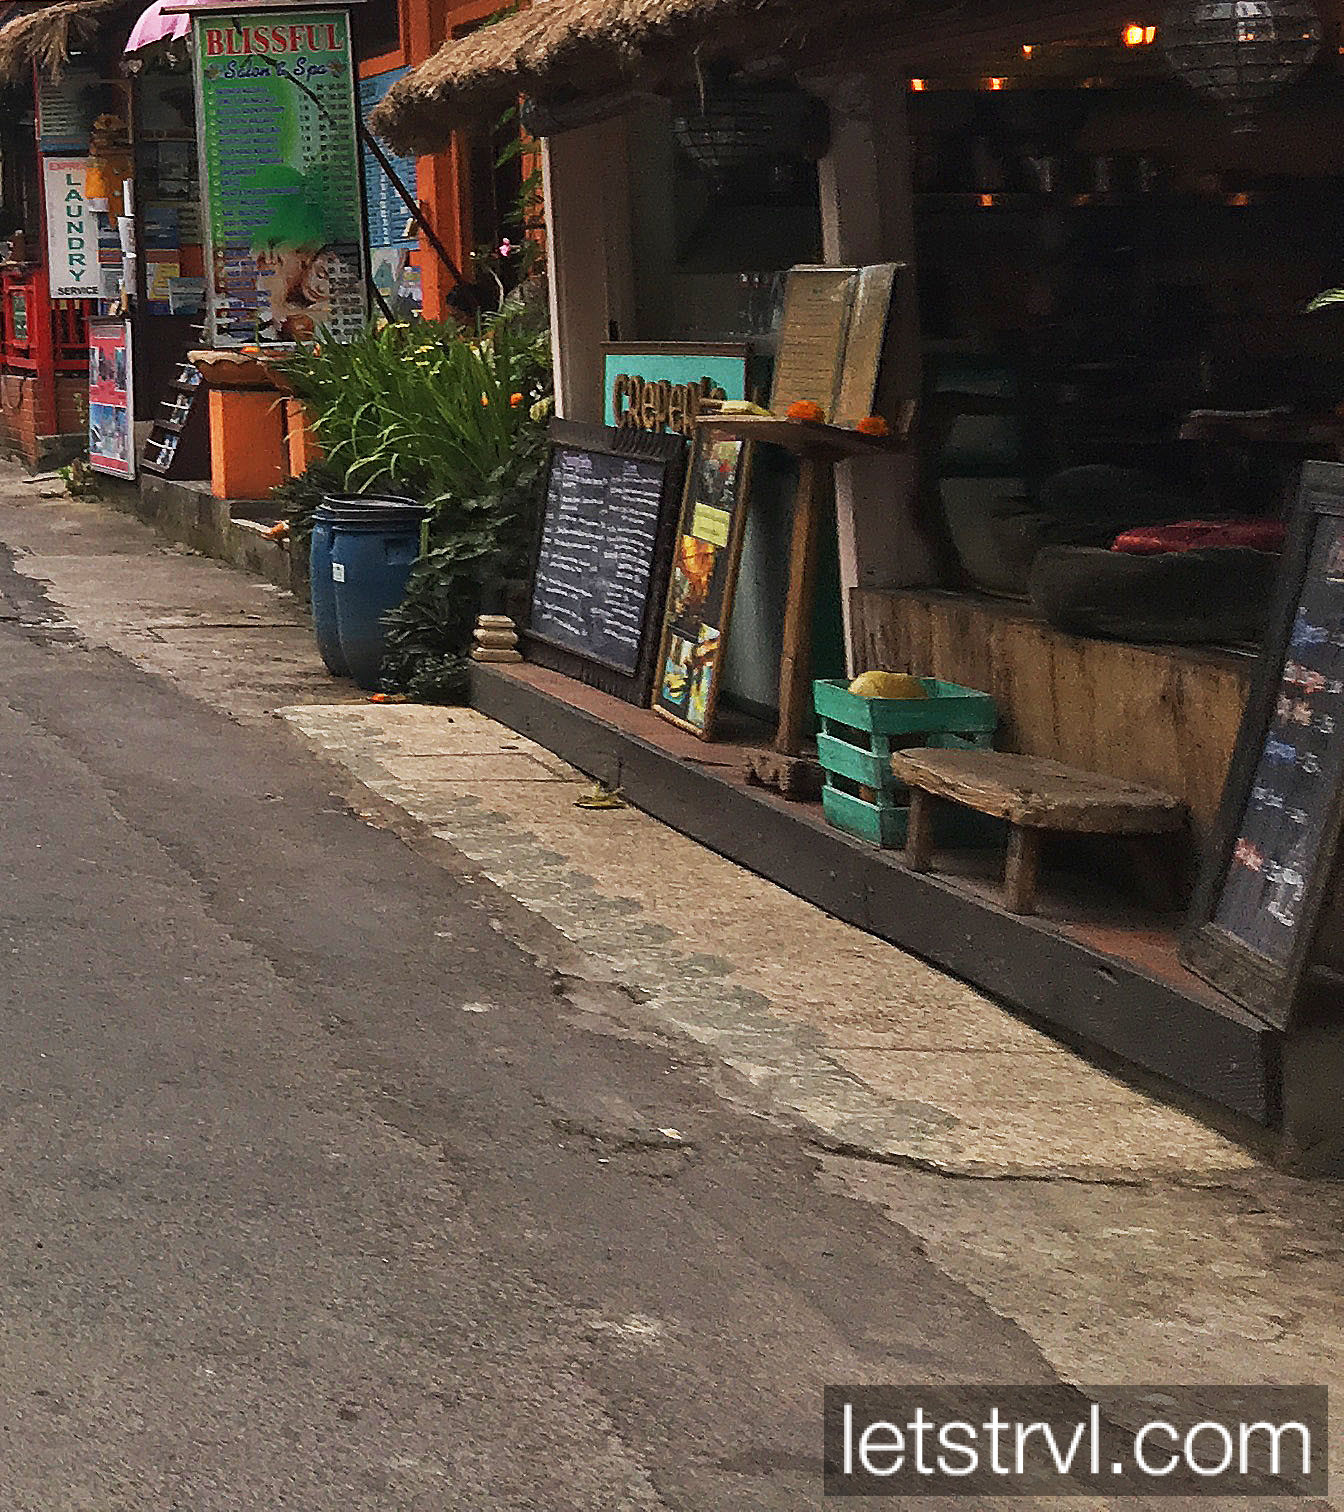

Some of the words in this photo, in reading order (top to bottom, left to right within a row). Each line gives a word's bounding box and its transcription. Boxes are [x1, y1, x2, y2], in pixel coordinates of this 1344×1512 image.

[206, 24, 343, 56] BLISSFUL
[225, 60, 272, 79] Salon
[294, 57, 328, 81] Spa
[65, 174, 86, 282] LAUNDRY
[58, 287, 99, 296] SERVICE
